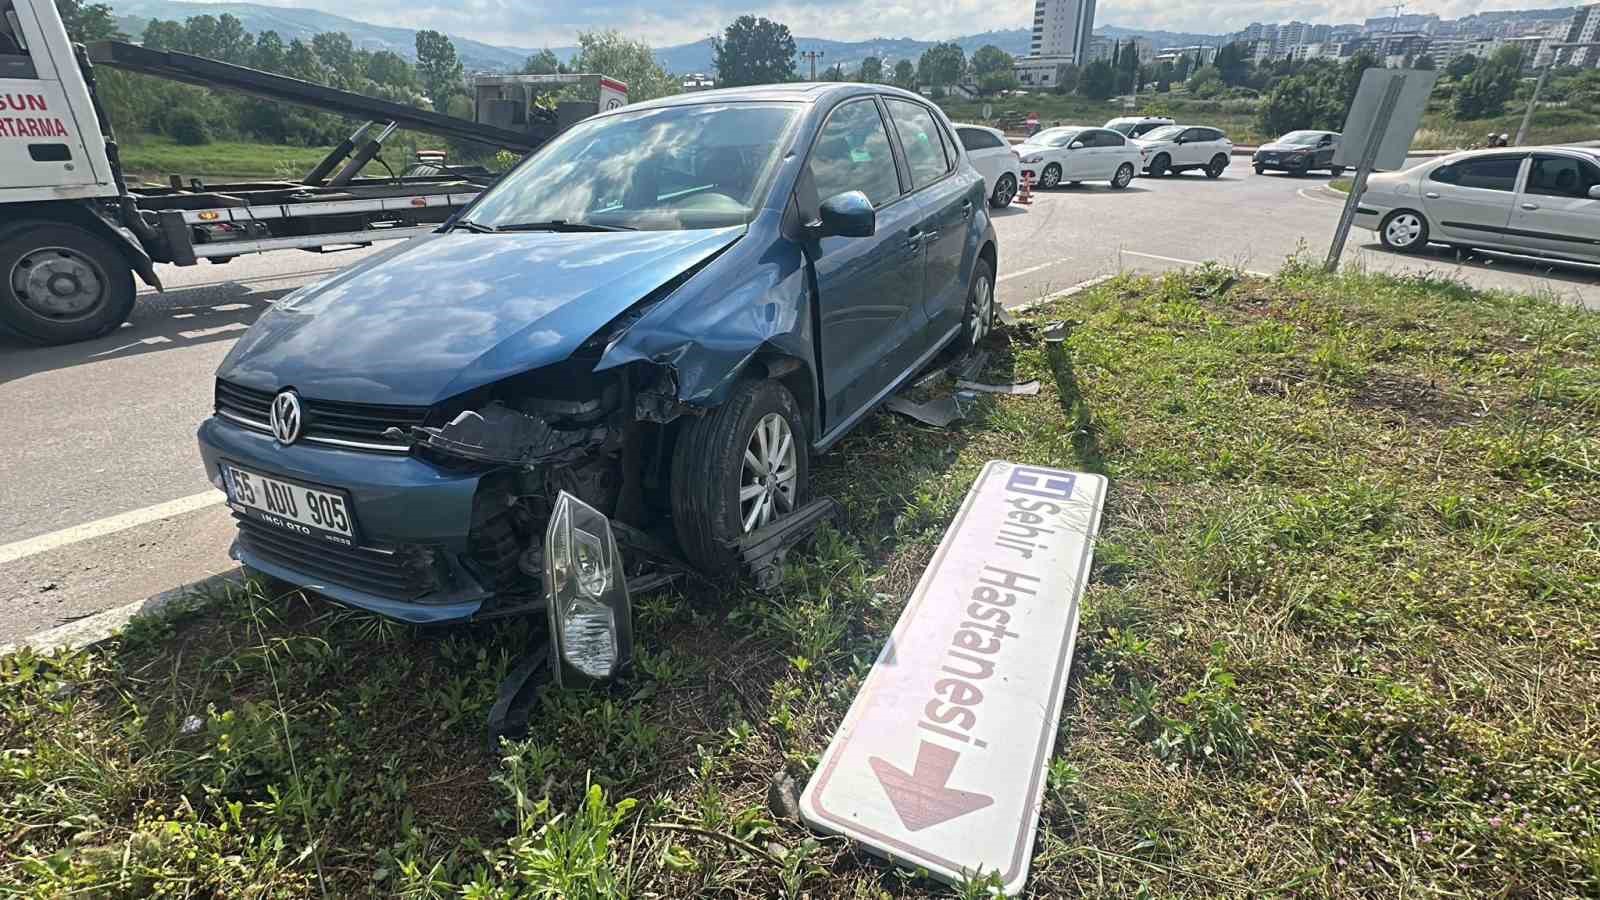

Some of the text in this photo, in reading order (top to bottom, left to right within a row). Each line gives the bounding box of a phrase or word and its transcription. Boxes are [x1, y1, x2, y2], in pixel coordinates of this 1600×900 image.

[231, 469, 348, 532] 55 ADU 905
[286, 521, 311, 536] OTO
[994, 497, 1061, 560] Şehir
[917, 564, 1041, 750] Hastanesi
